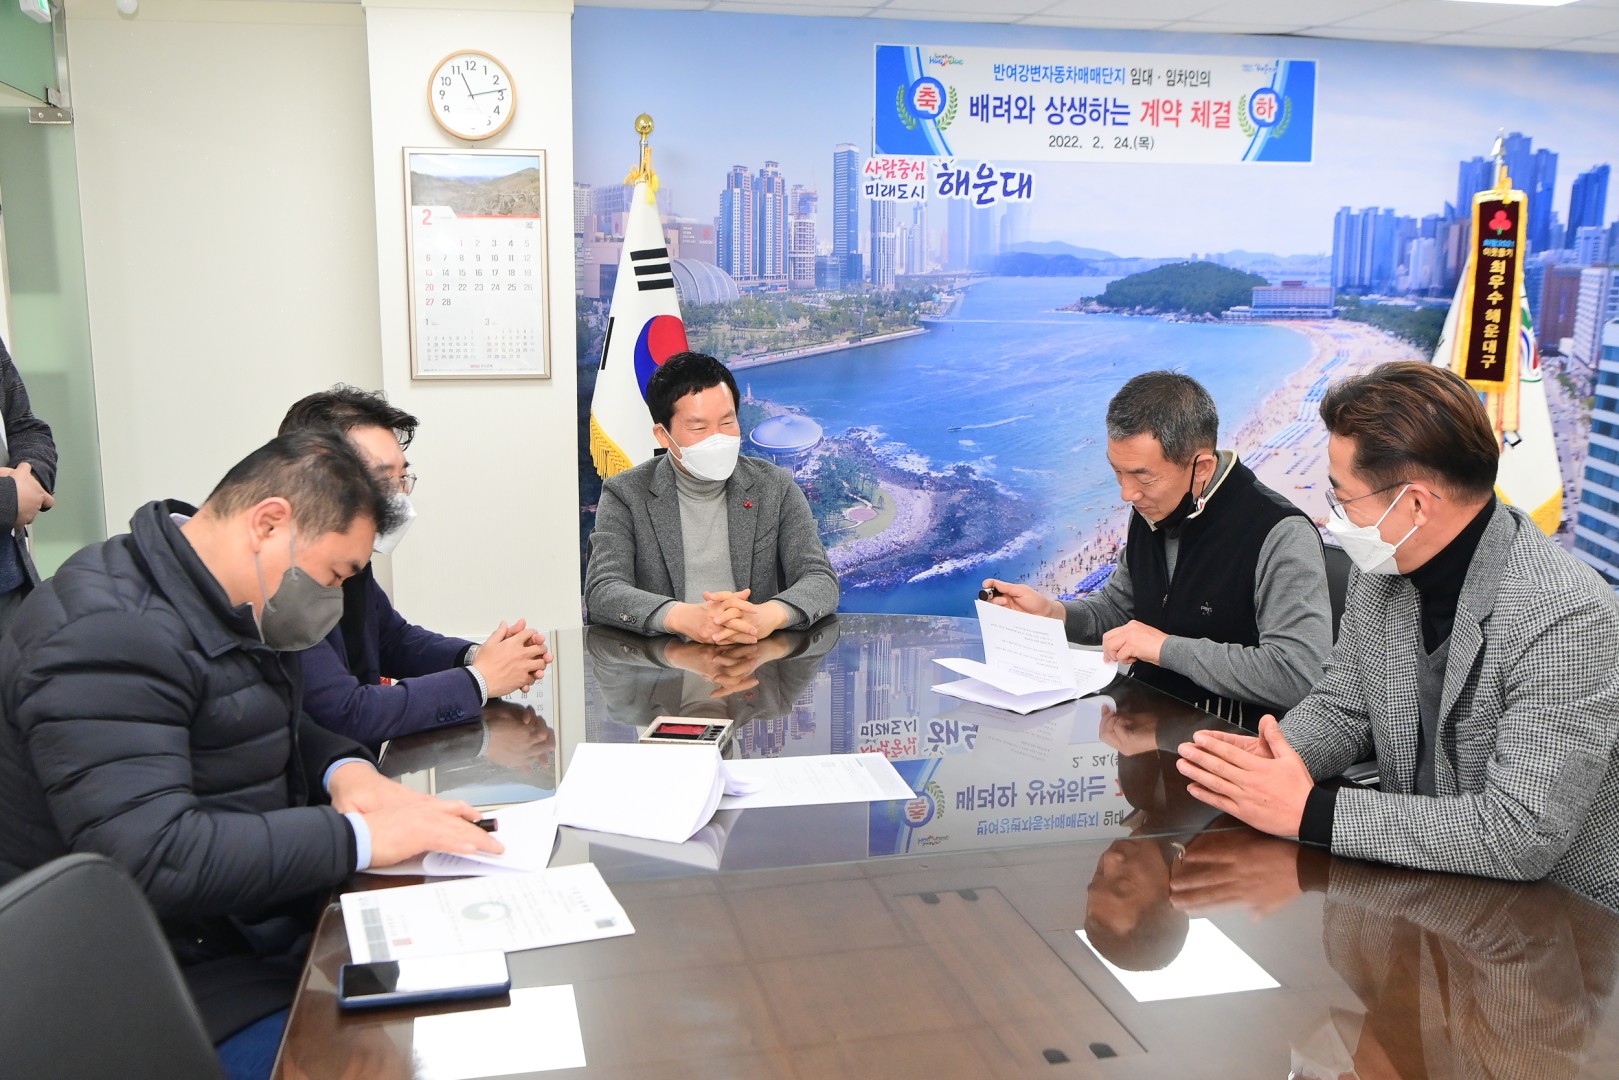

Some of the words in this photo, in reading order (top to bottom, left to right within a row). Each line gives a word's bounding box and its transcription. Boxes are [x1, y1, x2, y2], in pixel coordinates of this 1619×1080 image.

[451, 65, 461, 75] 11
[465, 60, 477, 71] 12
[483, 65, 487, 75] 1
[441, 76, 452, 87] 10
[492, 75, 500, 85] 2
[993, 63, 1127, 85] 반여강변자동차매매단지
[1130, 67, 1153, 87] 임대
[1165, 68, 1211, 88] 임차인의
[439, 89, 446, 100] 9
[497, 89, 504, 101] 3
[916, 87, 938, 111] 축
[493, 105, 500, 115] 4
[969, 93, 1036, 125] 배려와
[1044, 95, 1131, 127] 상생하는
[1139, 98, 1183, 128] 계약
[1190, 100, 1232, 129] 체결
[1256, 97, 1274, 119] 하
[1048, 134, 1083, 149] 2022.
[1092, 136, 1104, 149] 2.
[1113, 135, 1155, 151] 24.(목)
[865, 158, 926, 181] 사람중심
[936, 162, 1033, 205] 해운대
[865, 182, 925, 200] 미래도시
[422, 208, 432, 226] 2
[491, 254, 499, 262] 10
[508, 254, 514, 262] 11
[425, 283, 434, 291] 20
[442, 283, 450, 291] 21
[458, 283, 467, 291] 22
[474, 283, 484, 291] 23
[491, 283, 500, 291] 24
[507, 283, 516, 291] 25
[1486, 260, 1507, 305] 최우수
[425, 298, 434, 306] 27
[442, 298, 451, 306] 28
[485, 318, 490, 326] 3
[1480, 308, 1502, 369] 해운대구
